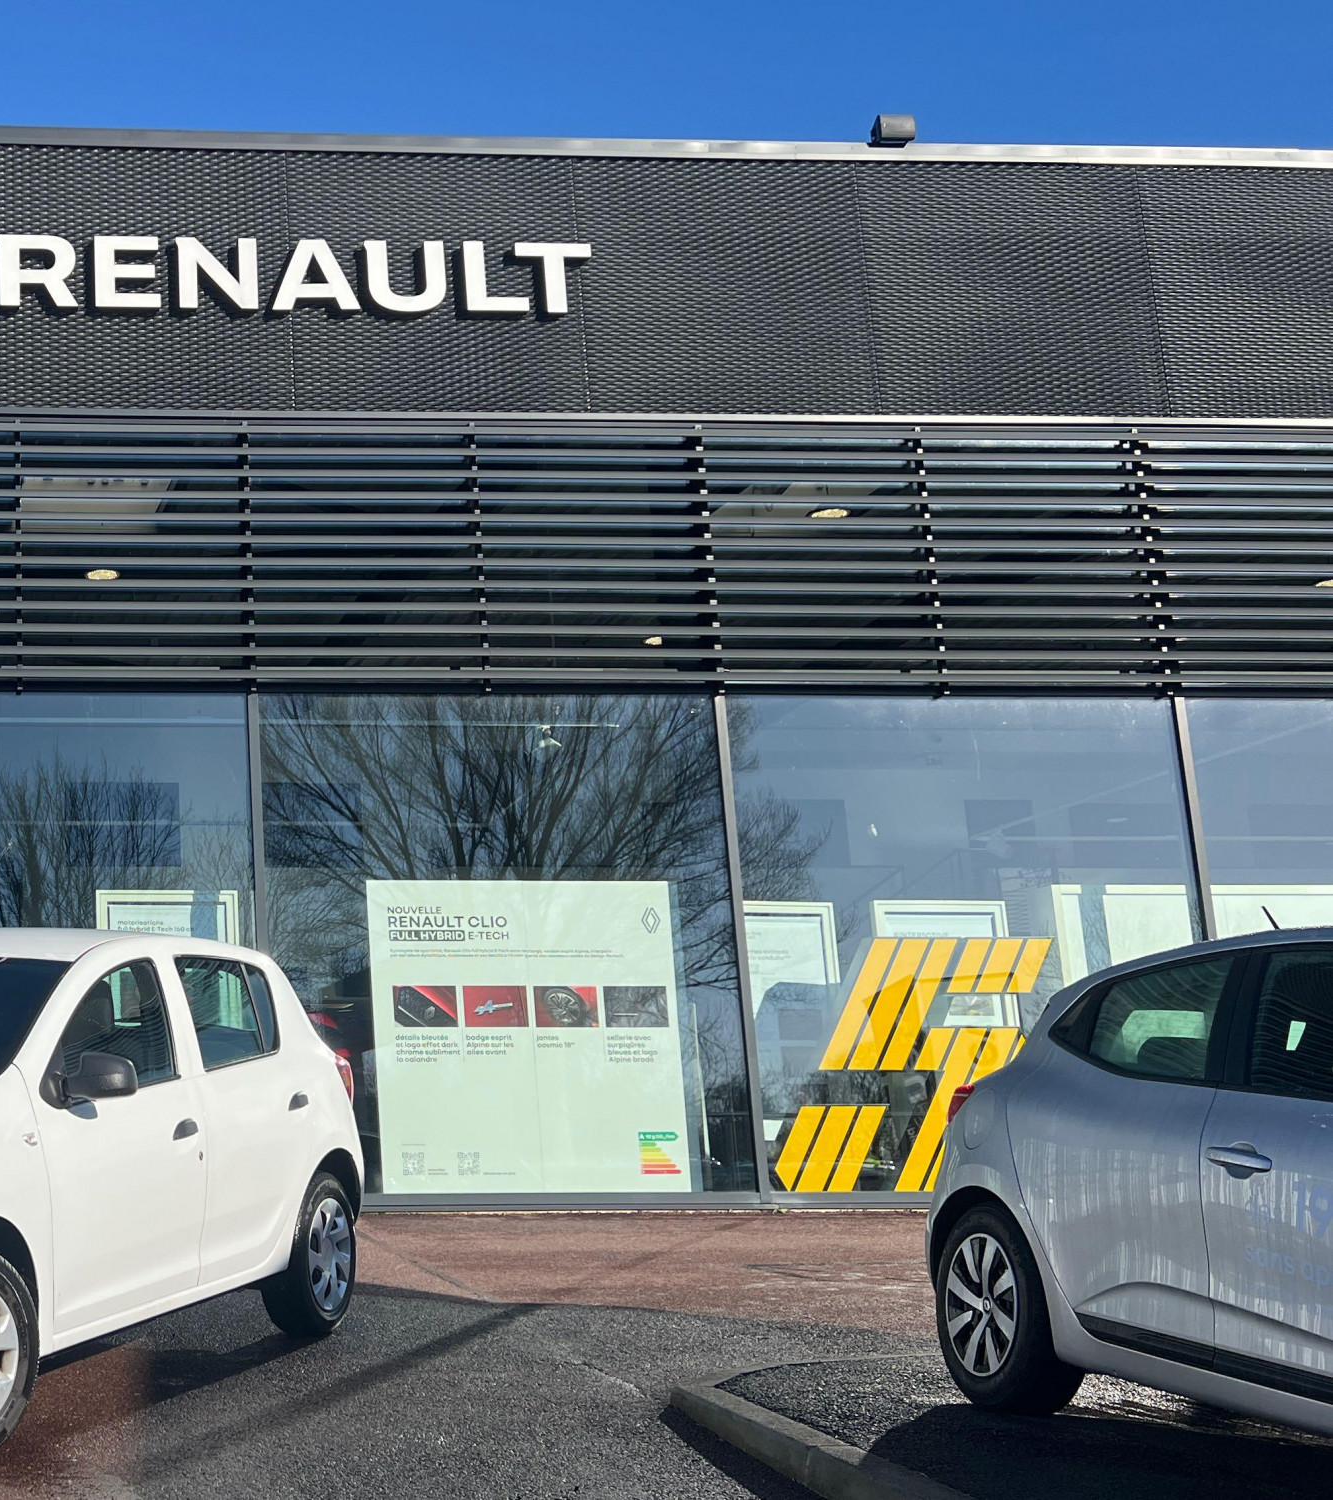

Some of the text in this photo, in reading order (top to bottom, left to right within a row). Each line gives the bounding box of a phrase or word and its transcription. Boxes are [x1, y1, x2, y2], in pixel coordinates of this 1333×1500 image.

[387, 906, 442, 914] NOUVELLE
[388, 916, 507, 928] RENAULT CLIO
[390, 931, 509, 940] FULL HYBRID E-TECH
[466, 1034, 512, 1042] badge esprit
[536, 1034, 559, 1042] jantes
[1244, 1244, 1295, 1275] sans
